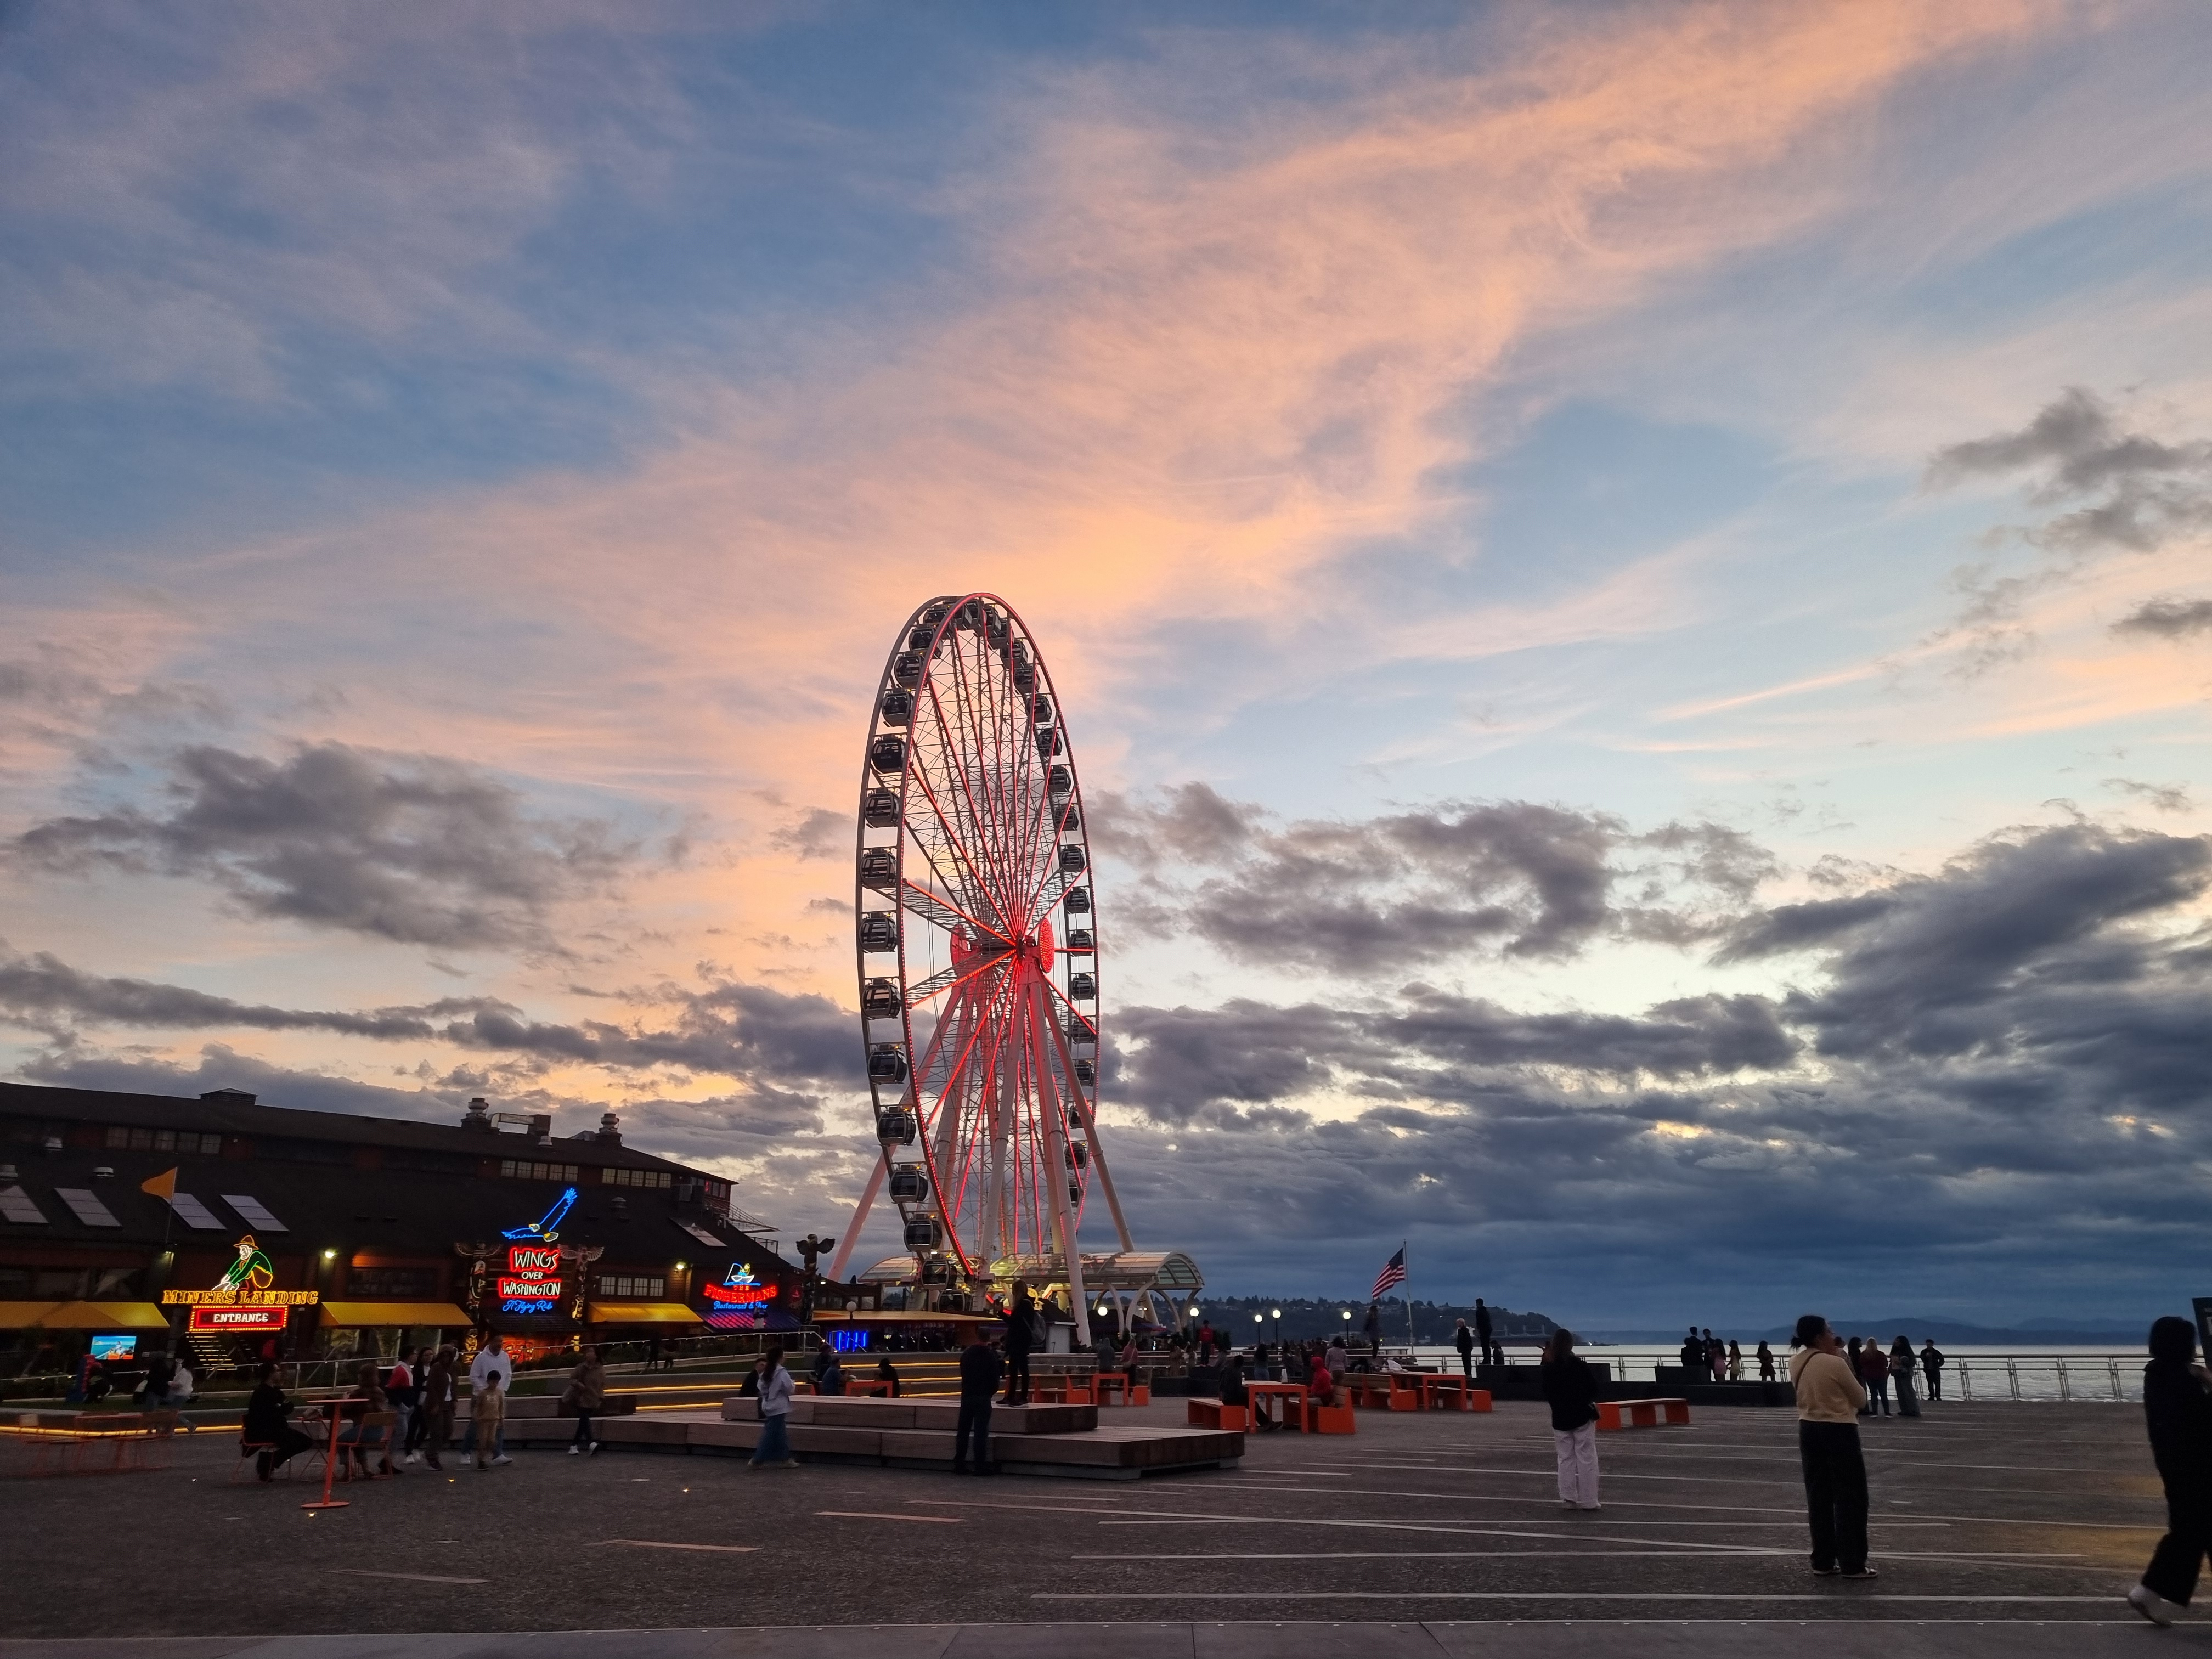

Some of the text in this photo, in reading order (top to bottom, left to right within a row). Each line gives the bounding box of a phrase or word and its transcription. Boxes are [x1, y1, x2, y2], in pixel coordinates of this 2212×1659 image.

[515, 1250, 560, 1270] WINGS
[522, 1271, 543, 1279] OVER
[503, 1280, 561, 1295] WASHINGTON
[703, 1284, 777, 1303] FISHERMANS
[161, 1290, 319, 1305] MINERS LANDING
[212, 1313, 269, 1323] ENTRANCE
